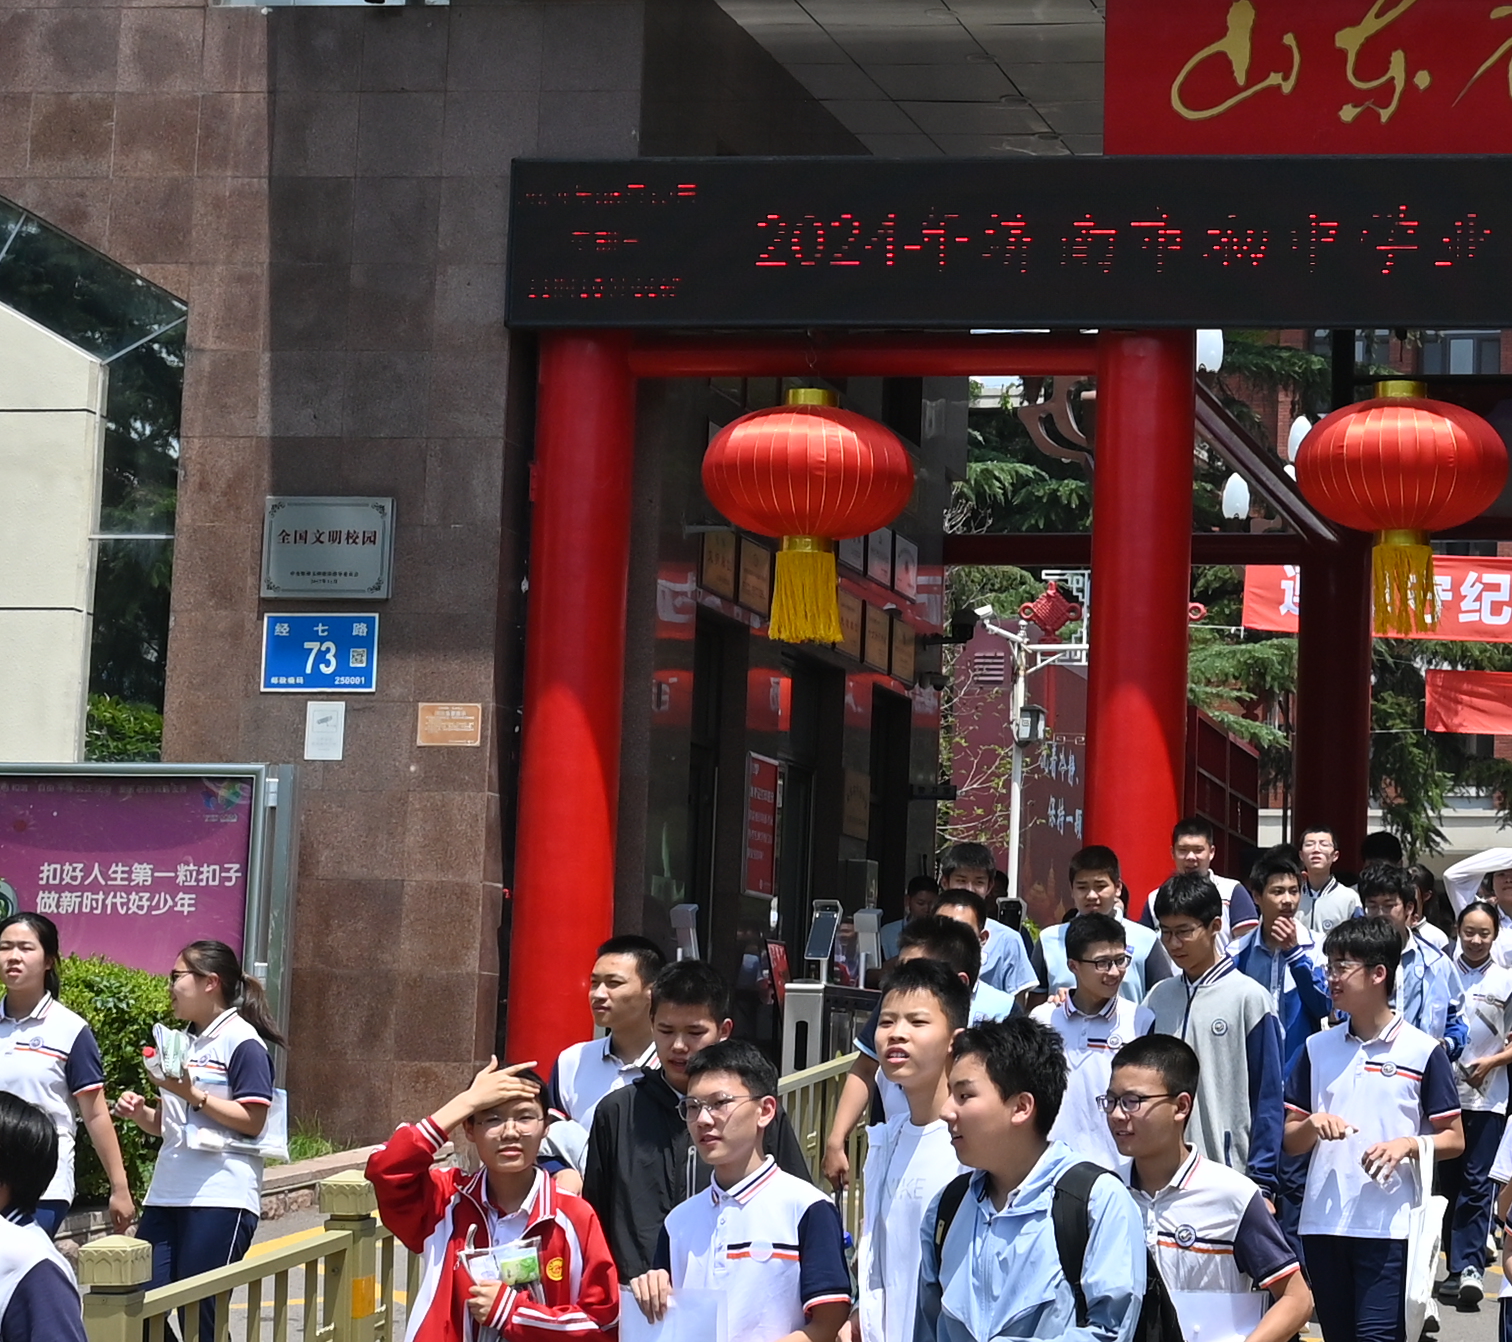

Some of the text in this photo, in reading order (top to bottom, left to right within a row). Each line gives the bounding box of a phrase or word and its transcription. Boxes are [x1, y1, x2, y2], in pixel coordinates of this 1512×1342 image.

[277, 529, 377, 546] 全国文明校园
[274, 623, 368, 637] 经七路
[304, 641, 336, 675] 73
[38, 862, 242, 887] 扣好人生第一粒扣子
[36, 890, 197, 916] 做新时代好少年
